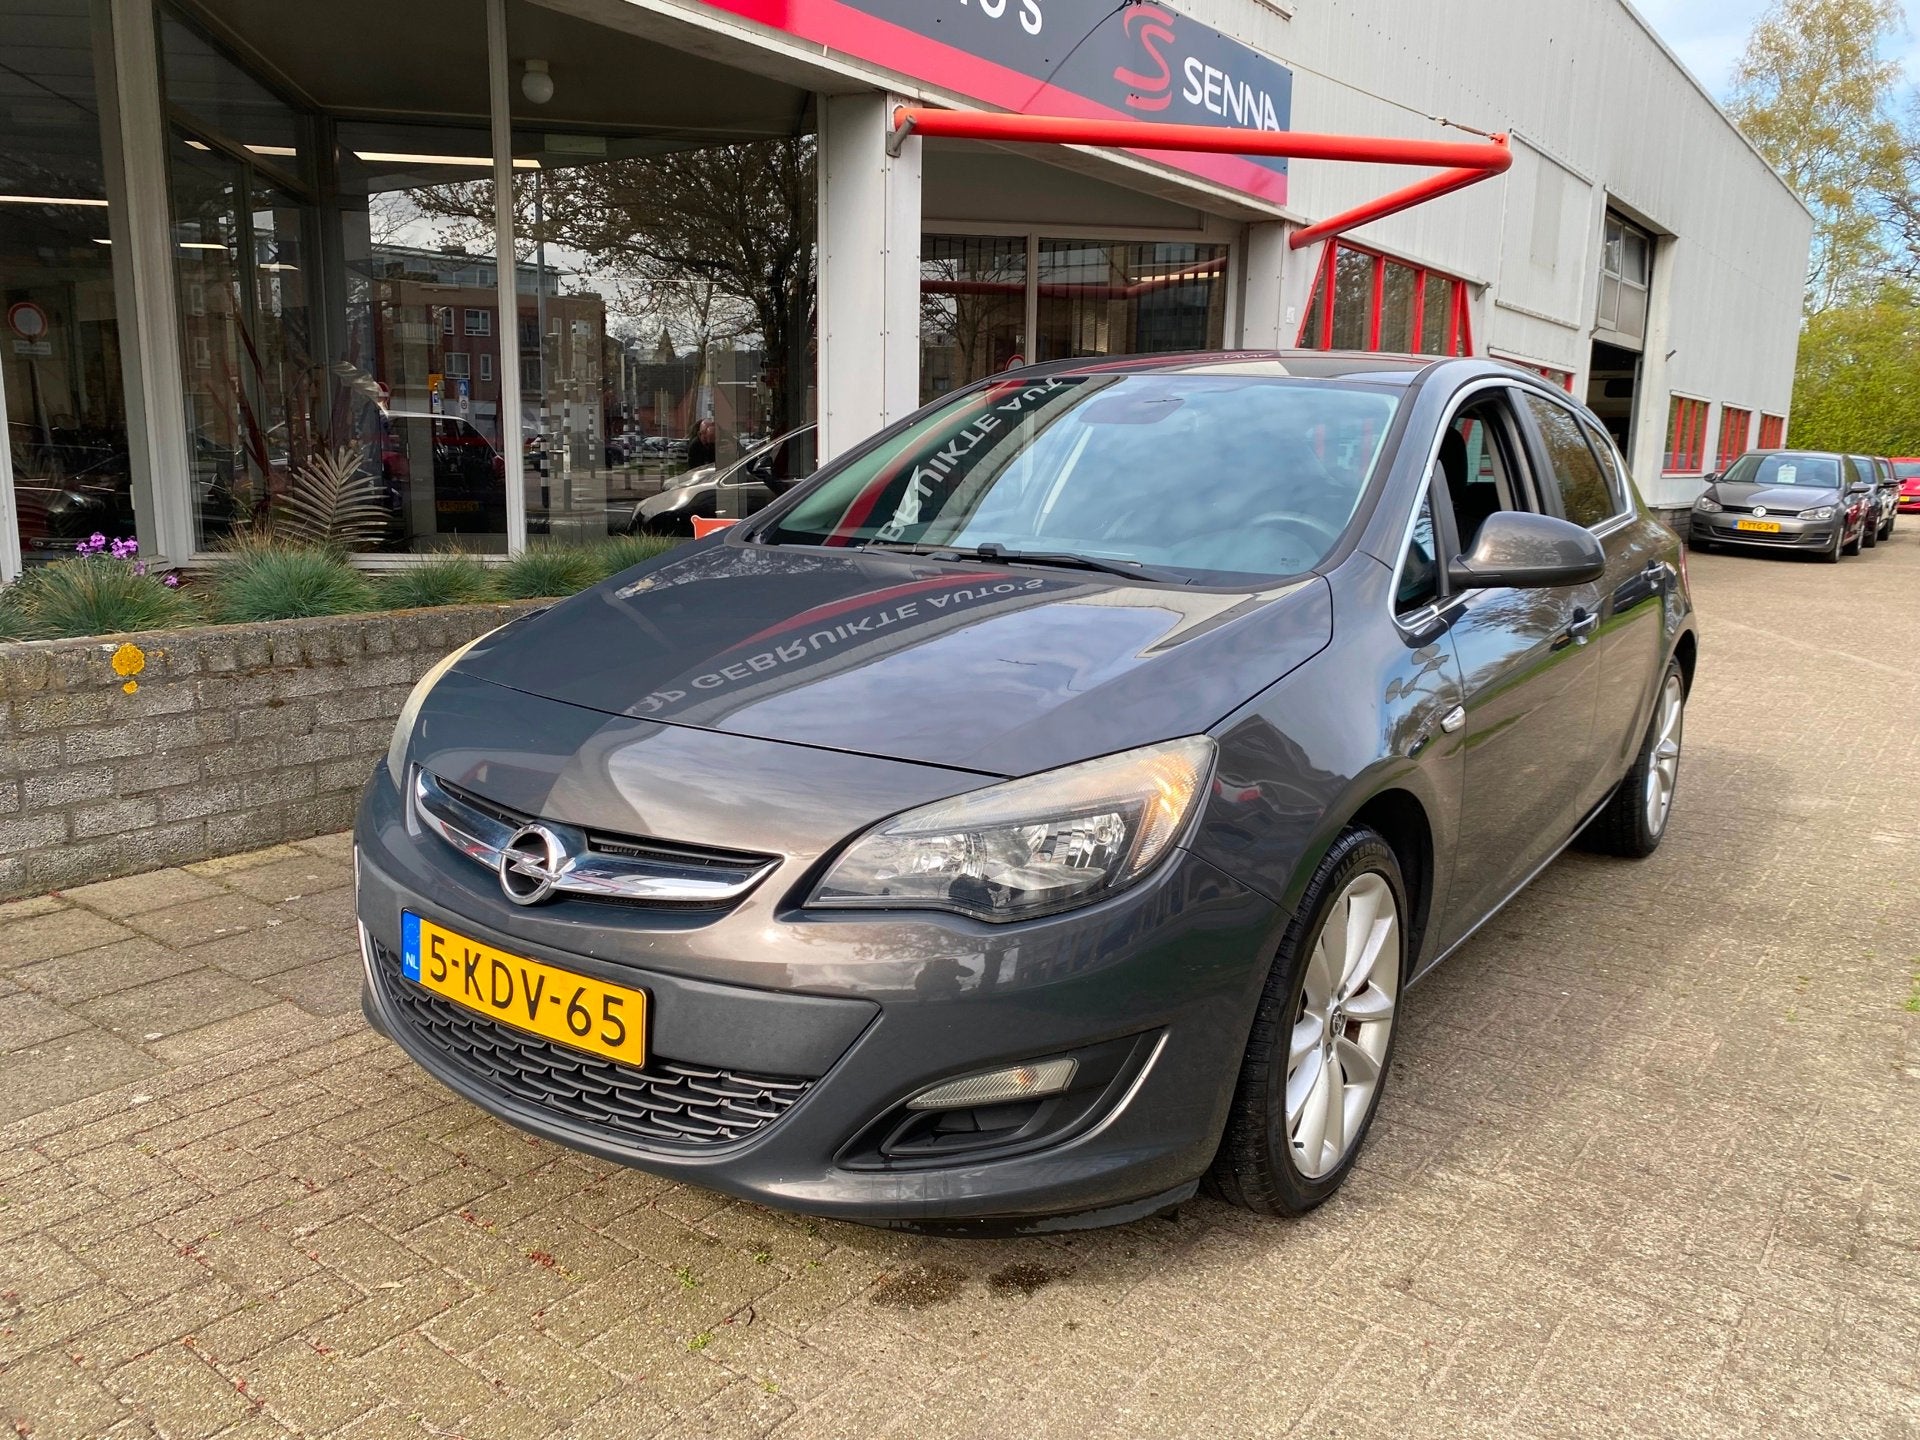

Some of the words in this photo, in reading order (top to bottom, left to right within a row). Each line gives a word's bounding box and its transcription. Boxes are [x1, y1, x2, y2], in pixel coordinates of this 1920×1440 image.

[1183, 57, 1280, 131] SENNA
[406, 952, 419, 970] NL
[430, 934, 626, 1047] 5-KDV-65
